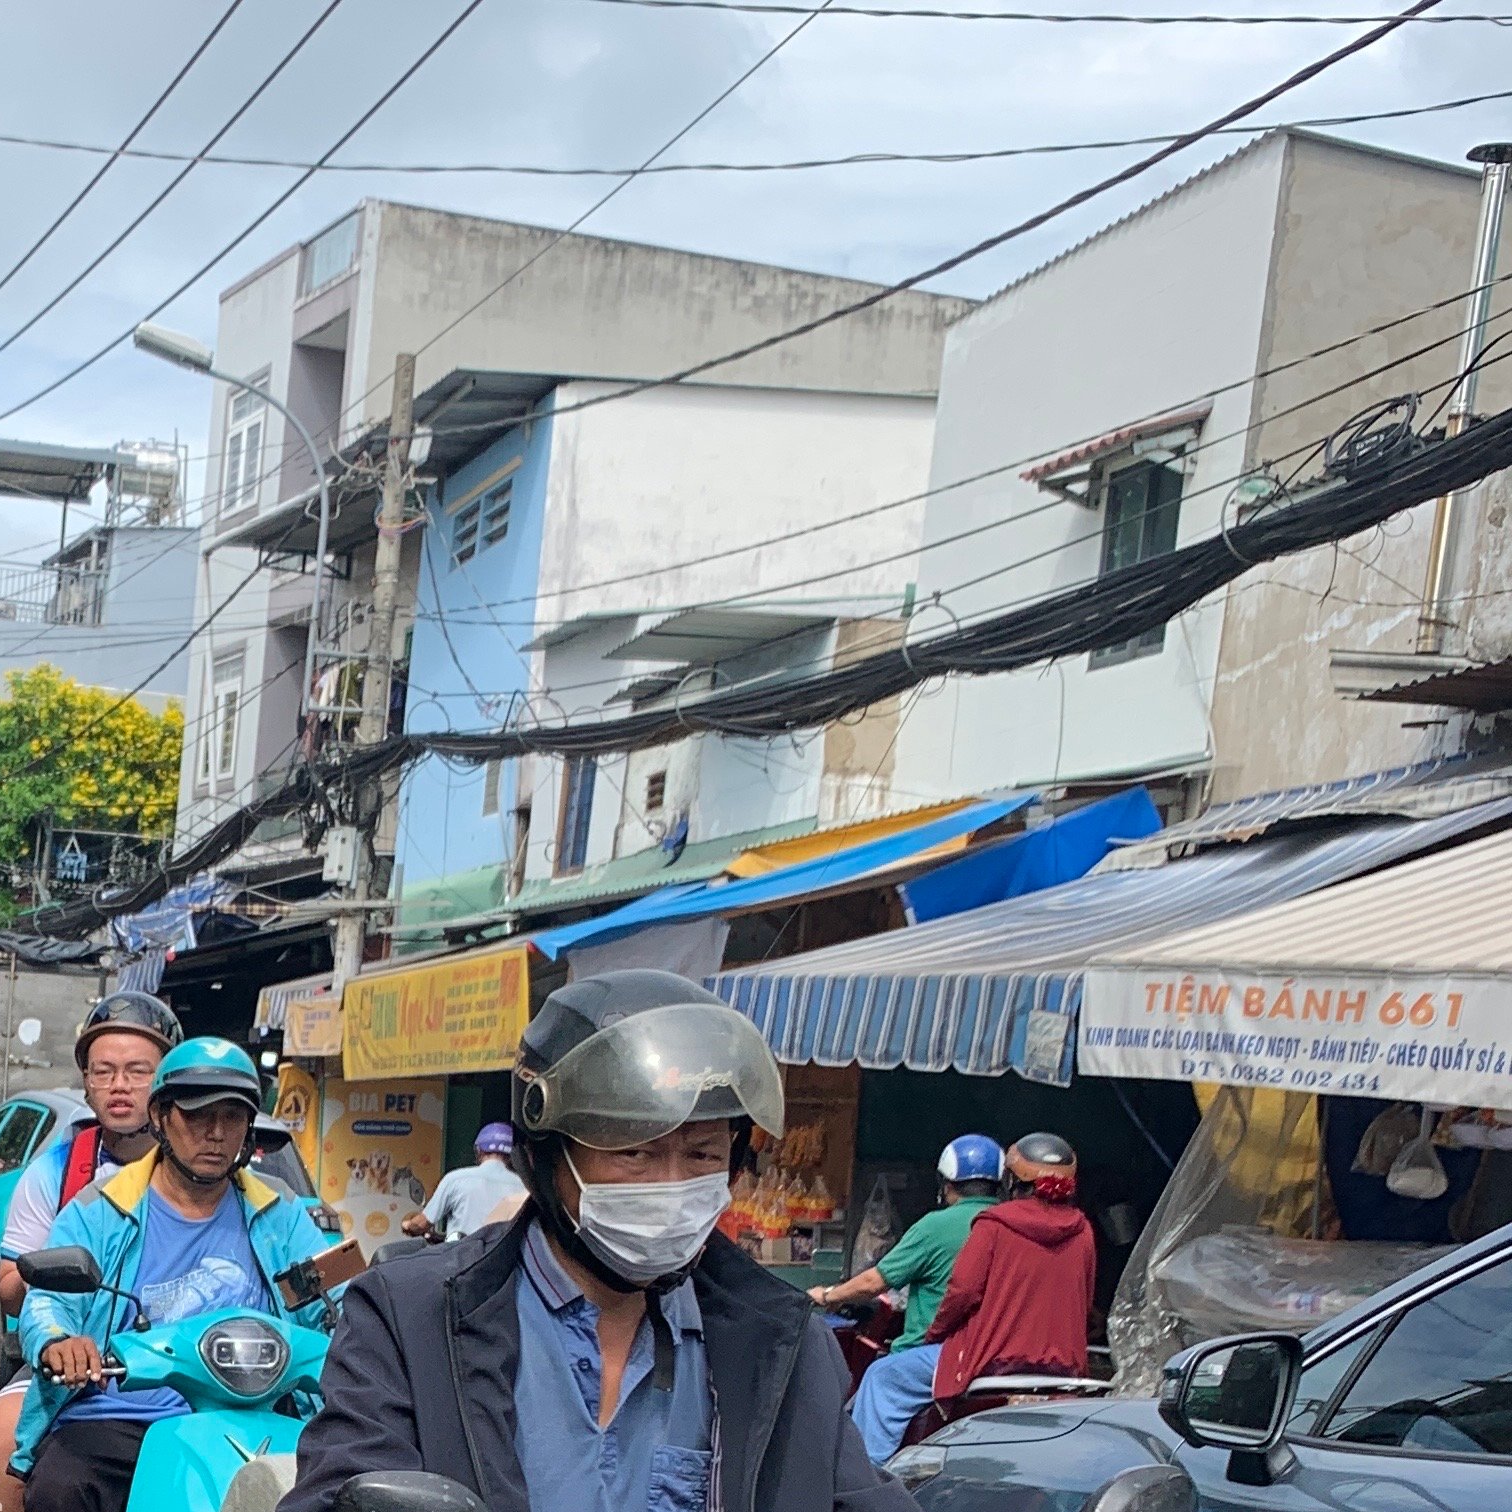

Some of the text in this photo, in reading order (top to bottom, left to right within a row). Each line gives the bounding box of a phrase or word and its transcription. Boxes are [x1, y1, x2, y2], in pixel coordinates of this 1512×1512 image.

[1144, 974, 1465, 1029] TIỆM BÁNH 661
[1115, 1027, 1151, 1049] DOANH
[1176, 1031, 1205, 1056] LOẠI
[1310, 1035, 1348, 1063] BÁNH
[1231, 1063, 1285, 1084] 0382
[1291, 1068, 1334, 1088] 002
[1338, 1072, 1381, 1092] 434
[384, 1092, 417, 1114] PET
